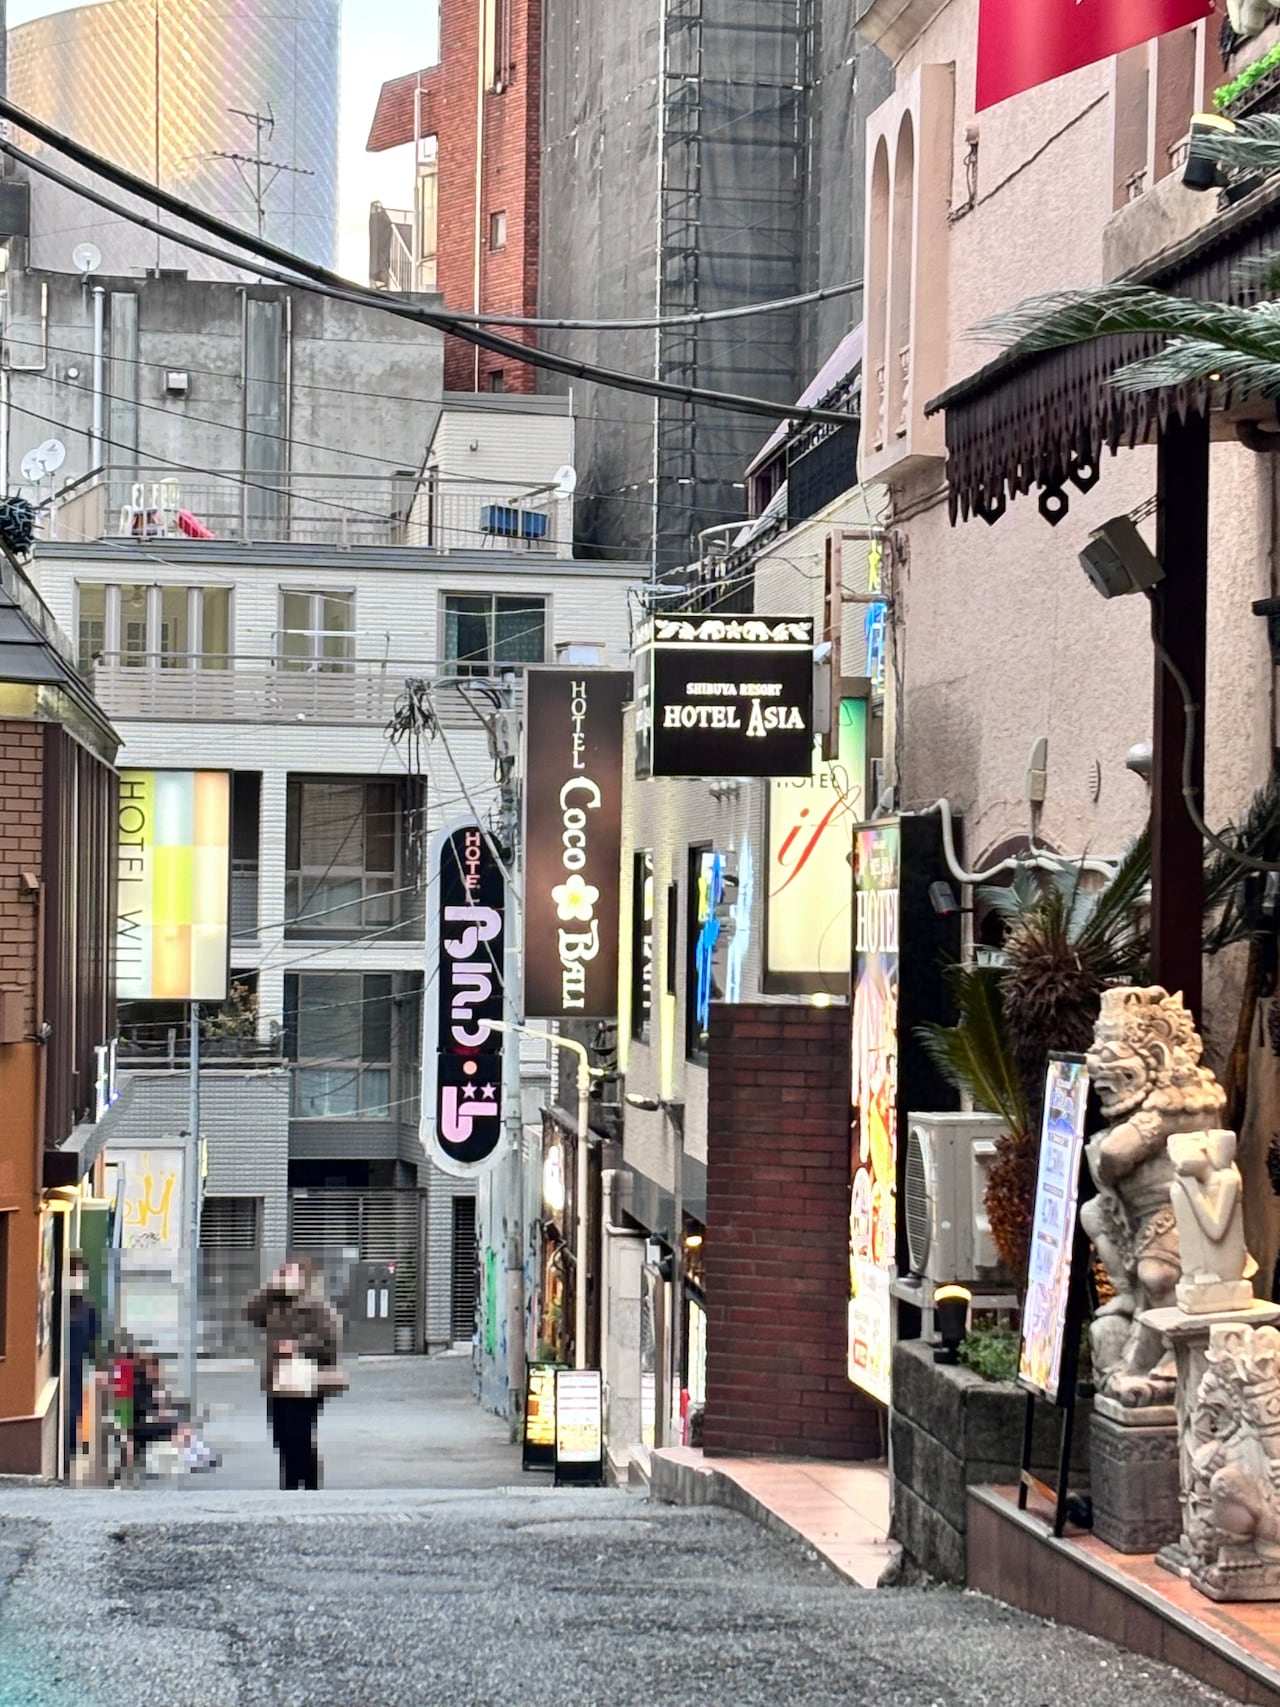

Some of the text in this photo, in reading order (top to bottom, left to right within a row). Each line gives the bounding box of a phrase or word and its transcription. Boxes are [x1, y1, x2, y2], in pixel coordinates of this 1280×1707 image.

[571, 681, 587, 769] HOTEL
[663, 705, 741, 728] HOTEL
[746, 698, 805, 737] ASIA
[686, 682, 783, 696] SHIBUYA RESORT
[464, 831, 481, 904] HOTEL
[770, 785, 862, 898] if
[856, 889, 900, 954] HOTEL
[558, 920, 600, 1009] BALI
